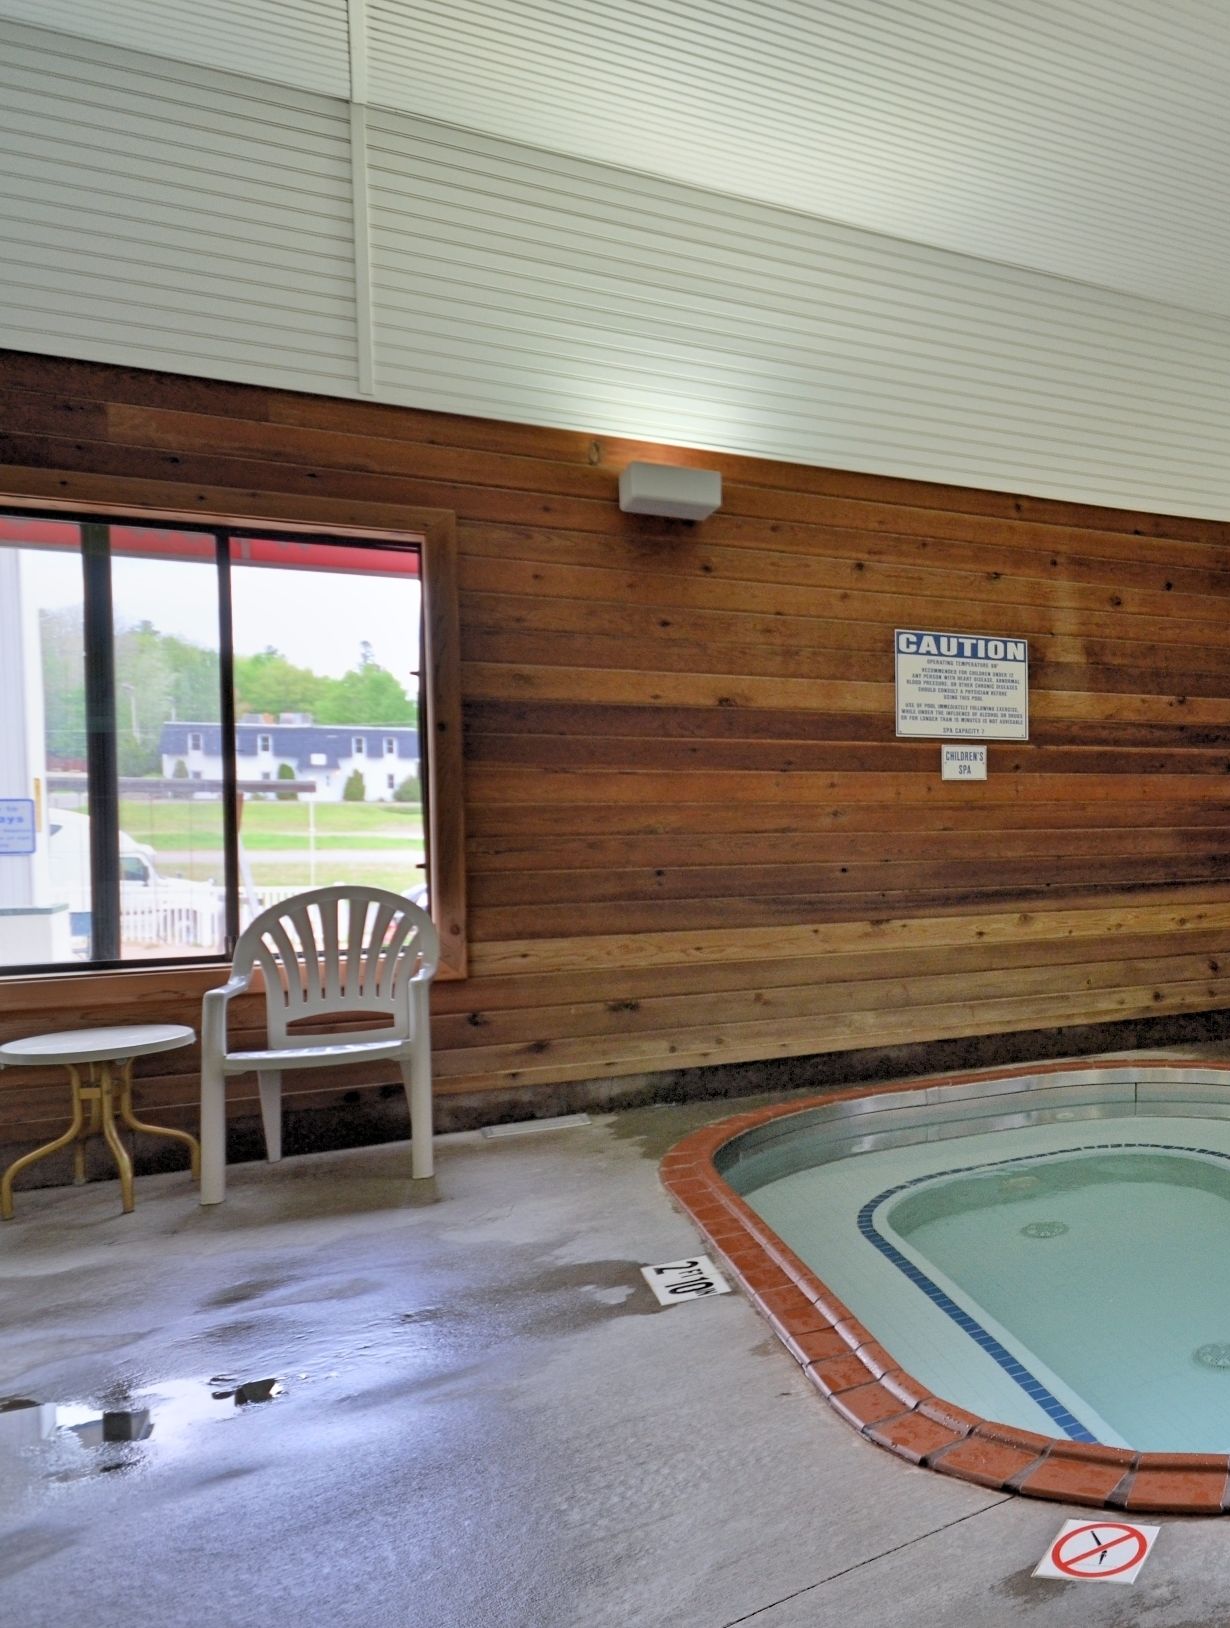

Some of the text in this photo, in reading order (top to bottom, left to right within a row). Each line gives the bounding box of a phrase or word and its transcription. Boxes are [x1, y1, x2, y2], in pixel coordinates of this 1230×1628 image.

[899, 634, 1024, 660] CAUTION
[946, 751, 983, 761] CHILDREN'S
[959, 765, 971, 774] SPA
